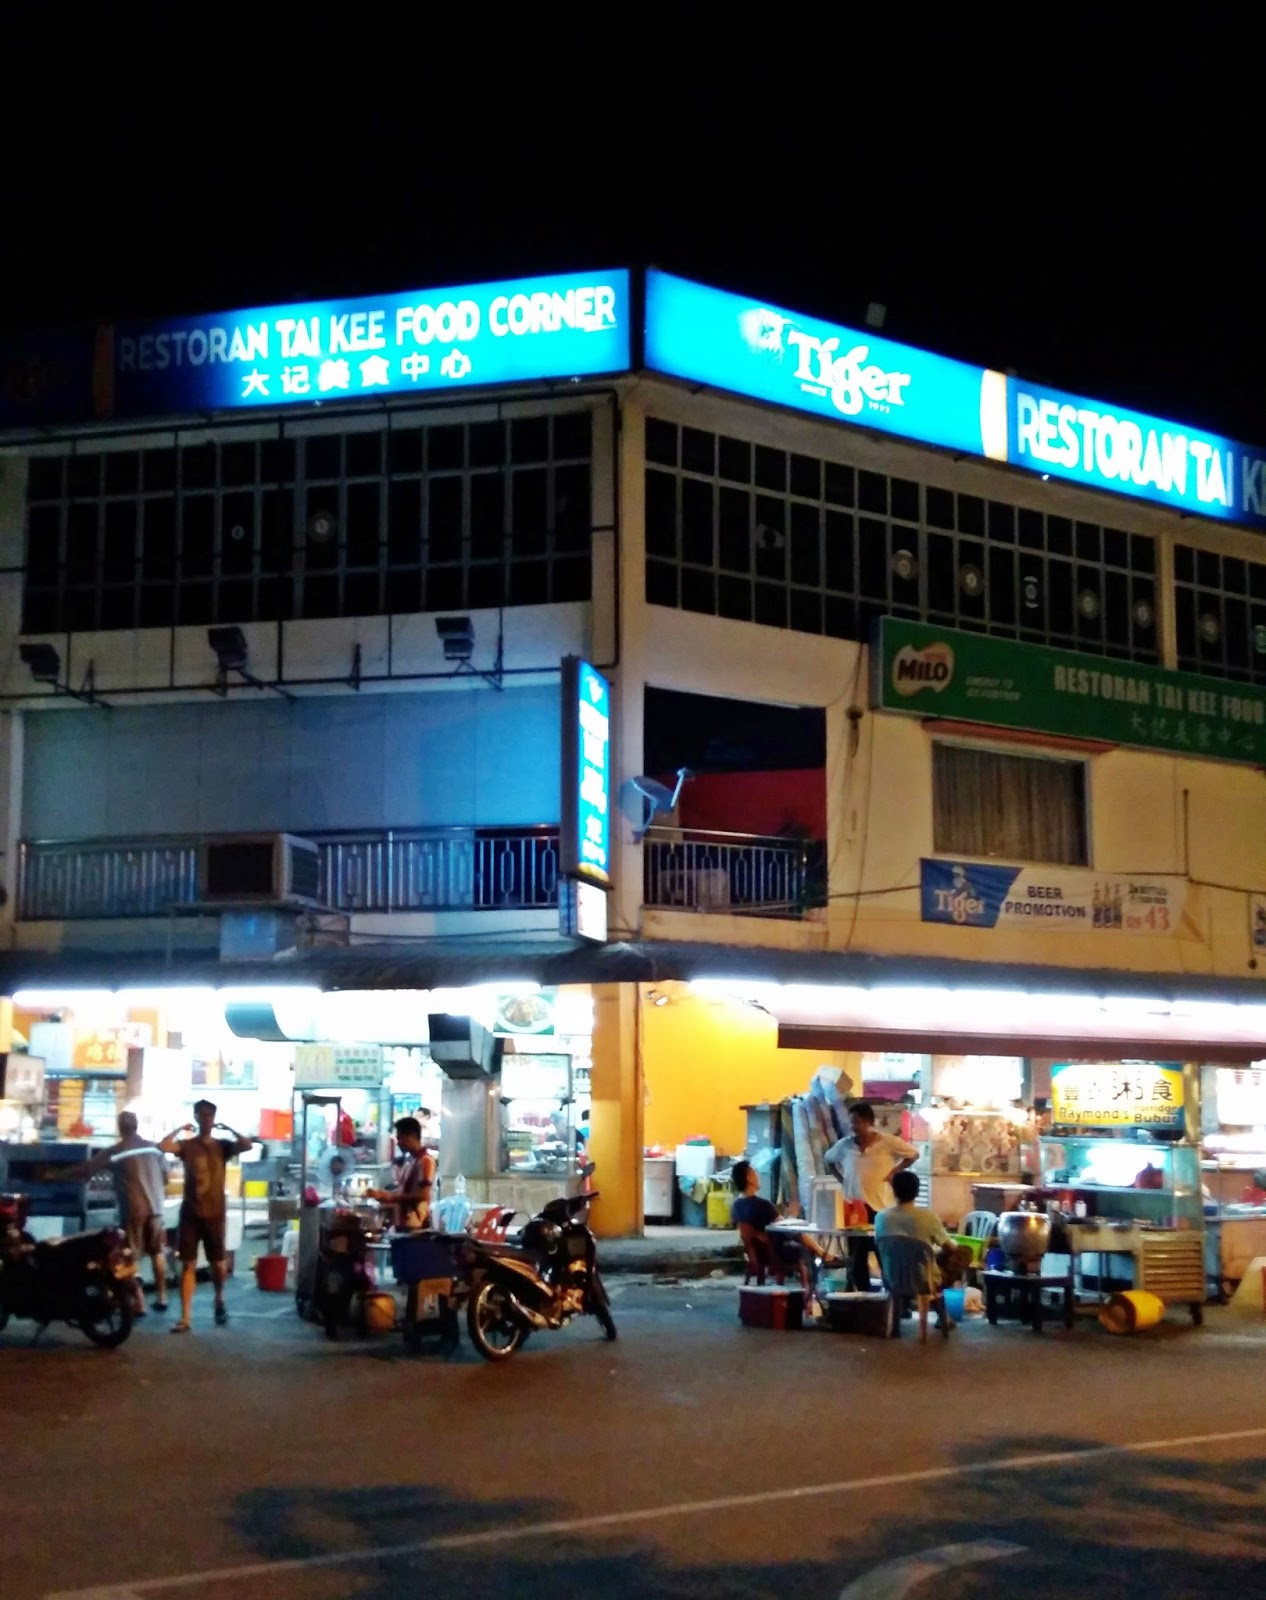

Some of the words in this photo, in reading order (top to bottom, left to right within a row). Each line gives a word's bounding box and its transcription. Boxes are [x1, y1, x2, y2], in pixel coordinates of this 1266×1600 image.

[119, 323, 269, 372] RESTORAN
[275, 317, 321, 358] TAI
[328, 310, 386, 353] KEE
[396, 300, 480, 346] FOOD
[488, 285, 617, 337] CORNER
[240, 348, 473, 398] 大记美食中心
[787, 330, 911, 415] Tiger
[1017, 393, 1188, 496] RESTORAN
[1189, 440, 1234, 507] TAI
[897, 659, 949, 681] MILO
[1054, 665, 1150, 705] RESTORAN
[1155, 683, 1183, 711] TAI
[934, 888, 985, 924] Tiger
[1005, 900, 1086, 918] PROMOTION
[1027, 884, 1063, 901] BEER
[1059, 1107, 1130, 1122] Raymonds
[1135, 1104, 1178, 1115] orridge
